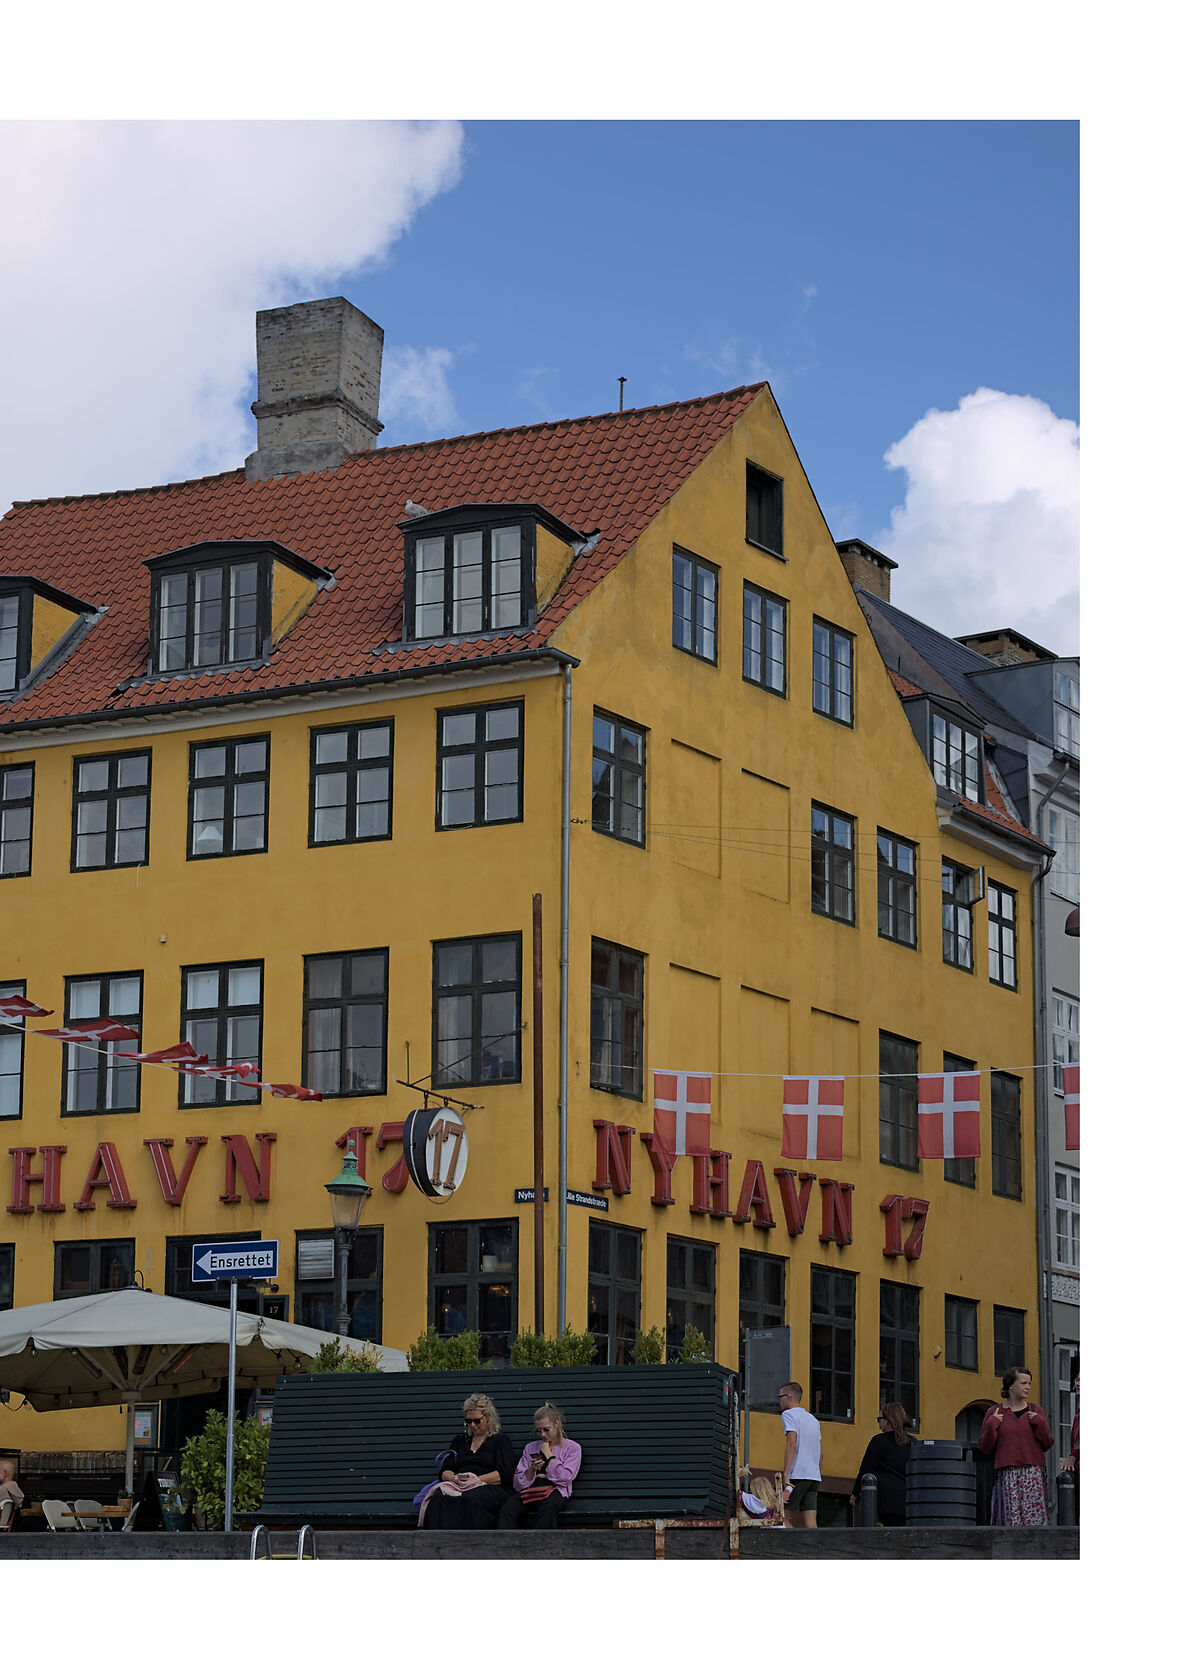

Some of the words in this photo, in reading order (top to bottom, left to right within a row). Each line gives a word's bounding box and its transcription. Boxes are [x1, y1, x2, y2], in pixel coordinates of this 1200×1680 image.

[335, 1121, 409, 1196] 17
[428, 1118, 466, 1190] 17
[518, 1191, 545, 1200] Nyha
[592, 1118, 855, 1247] NYHAVN
[879, 1193, 931, 1261] 17
[210, 1253, 271, 1268] Ensrettet
[269, 1306, 279, 1314] 17
